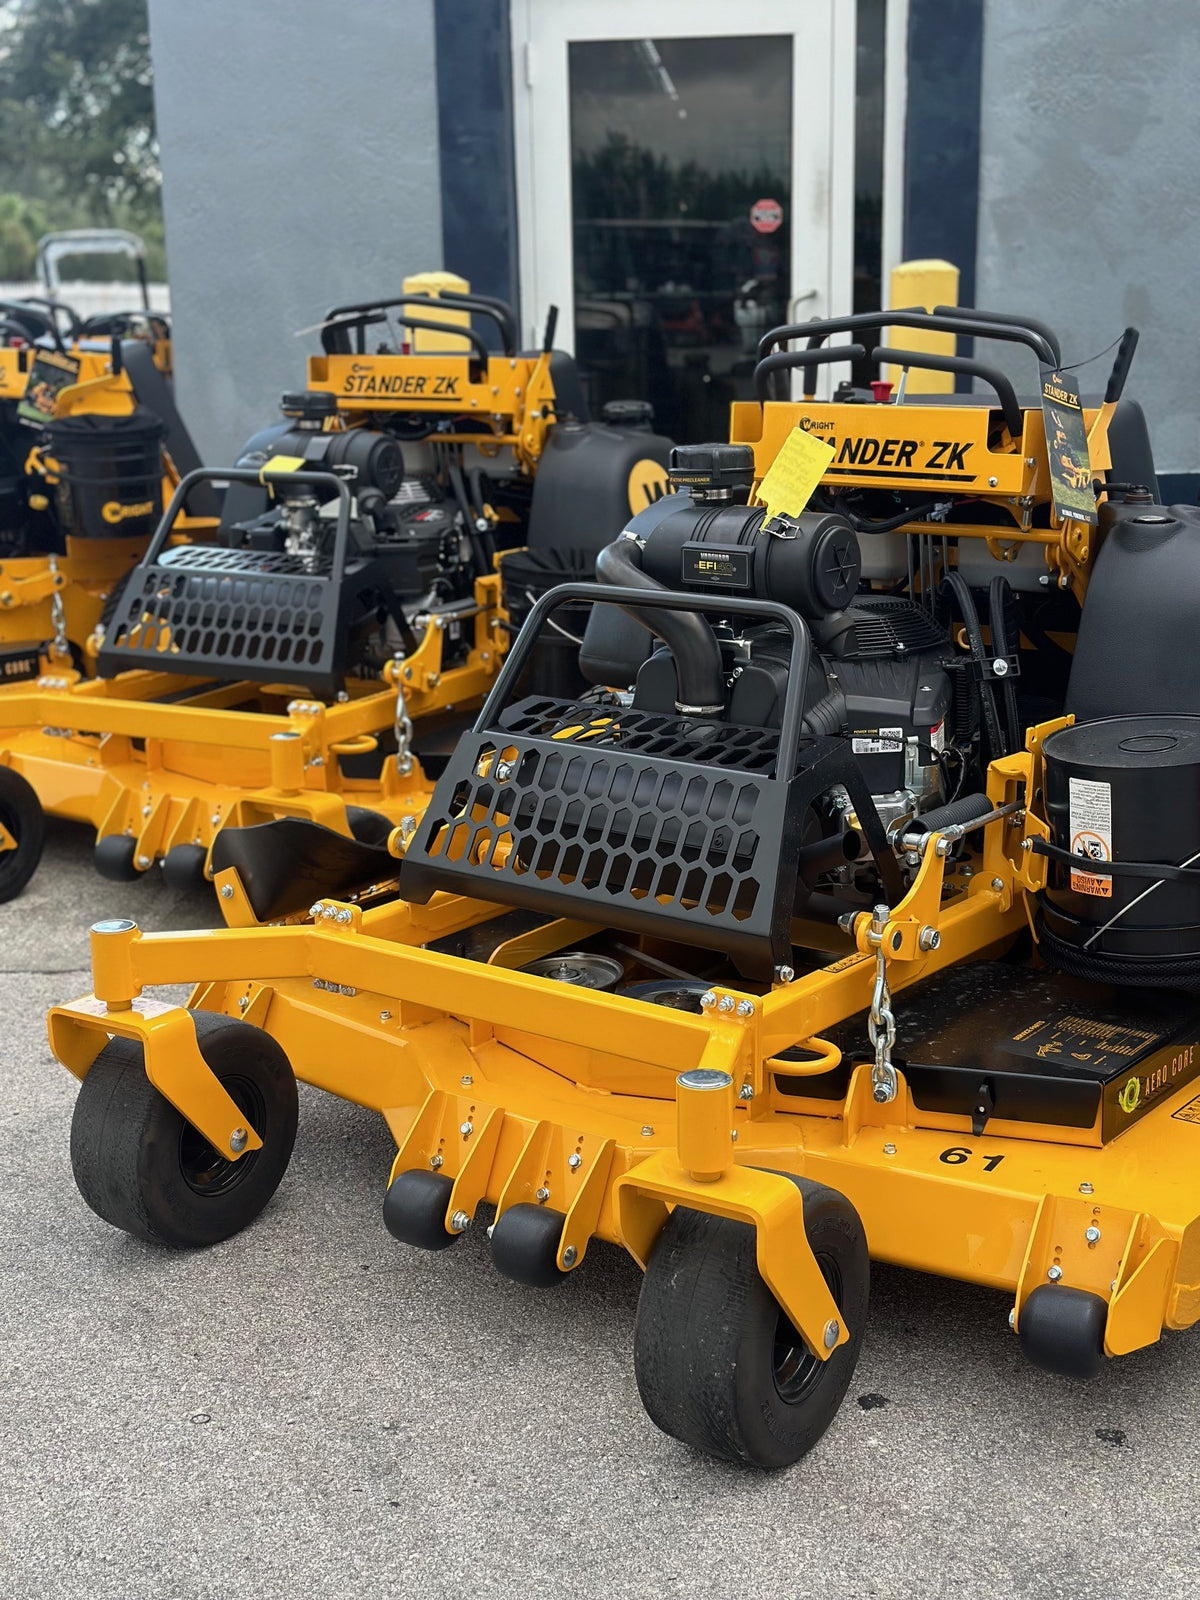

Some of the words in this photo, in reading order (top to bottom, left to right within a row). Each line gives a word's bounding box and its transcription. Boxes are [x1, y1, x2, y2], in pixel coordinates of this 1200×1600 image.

[344, 375, 426, 393] STANDER
[433, 377, 459, 394] ZK
[1044, 383, 1068, 402] STANDER
[1069, 393, 1078, 405] ZK
[799, 417, 835, 431] WRIGHT
[925, 442, 974, 470] ZK
[1072, 881, 1100, 895] WARNING
[1145, 1065, 1168, 1096] AERO
[1172, 1045, 1194, 1076] CORE
[939, 1147, 1005, 1172] 61
